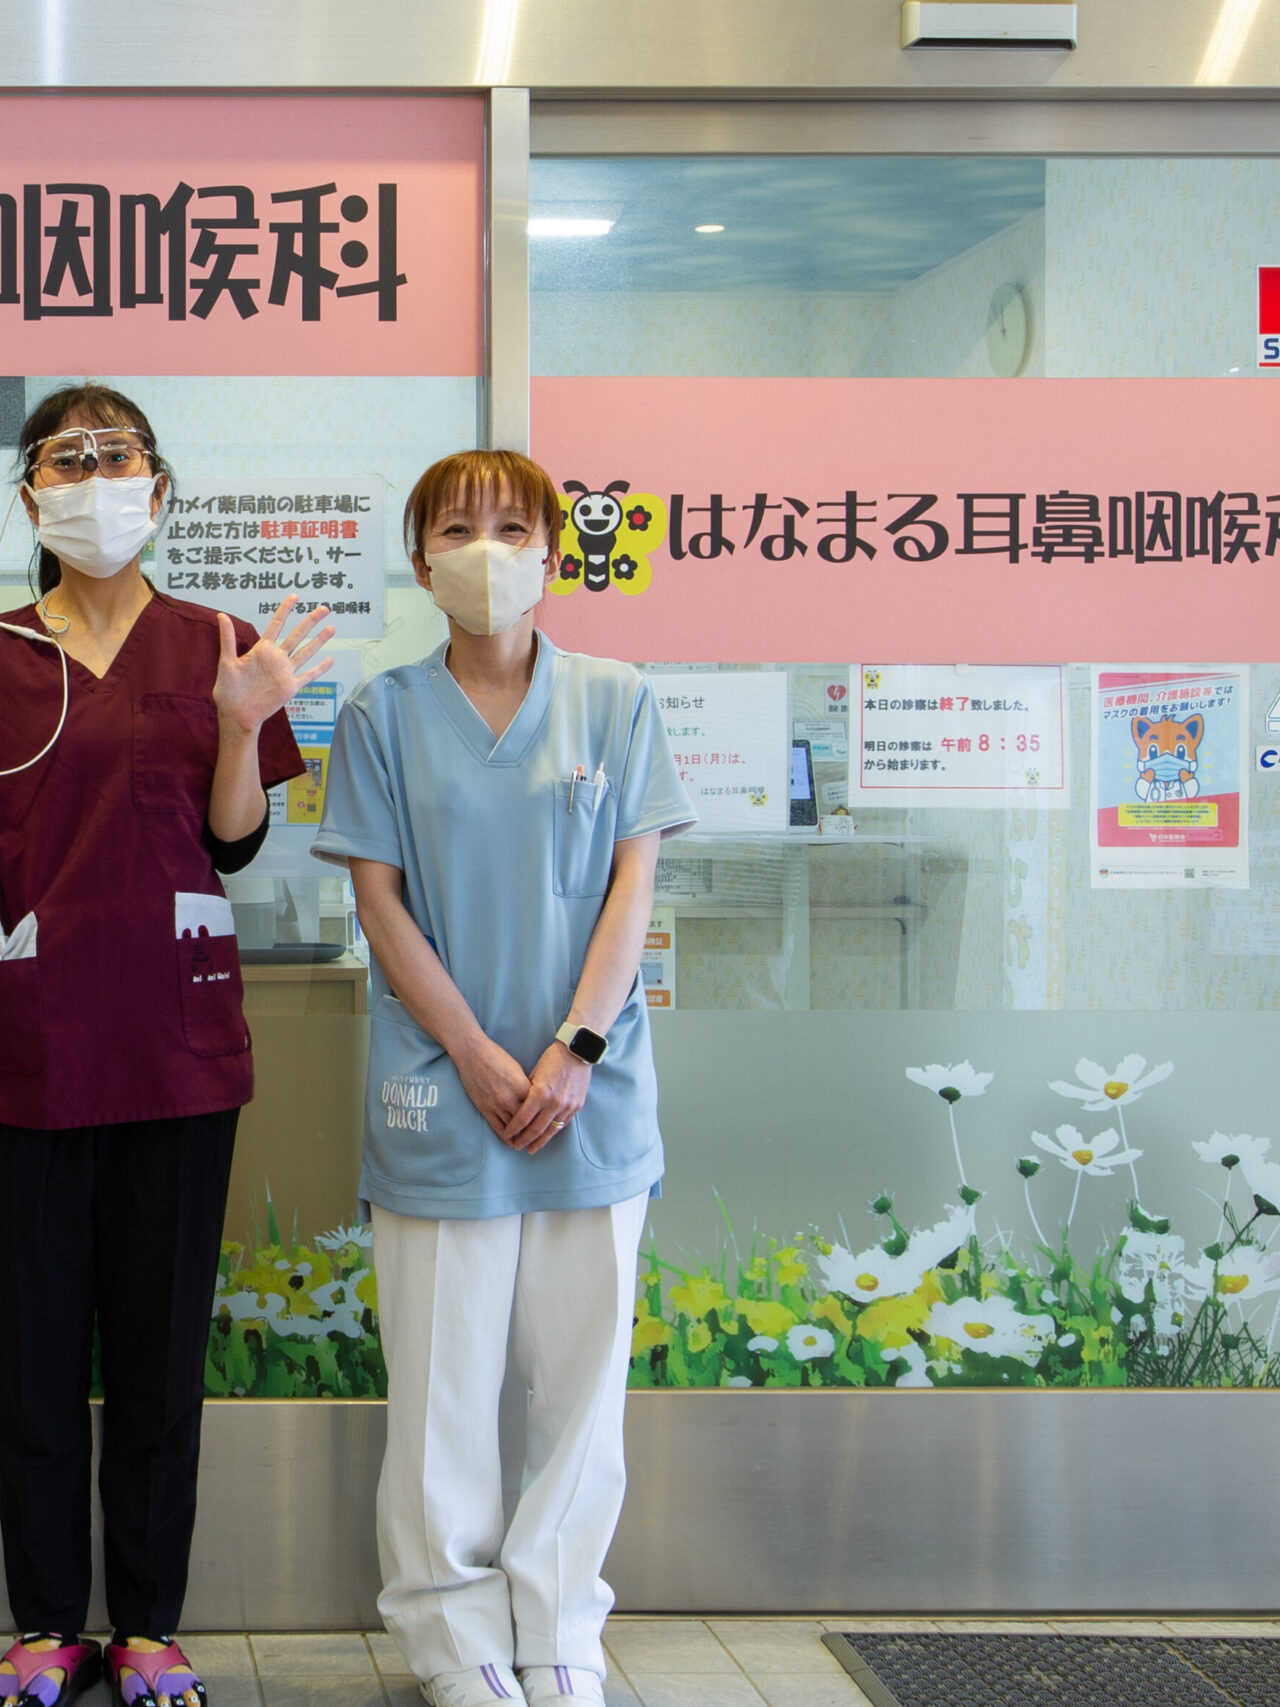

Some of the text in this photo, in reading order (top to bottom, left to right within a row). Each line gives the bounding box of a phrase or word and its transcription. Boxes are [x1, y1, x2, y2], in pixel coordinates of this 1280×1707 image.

[167, 495, 371, 514] カメイ薬局前の駐車場に
[167, 520, 359, 539] 止めた方は駐車証明書
[167, 572, 354, 590] ビス券をお出しします。
[1103, 685, 1234, 708] 医療機関、介護施設等では
[941, 738, 971, 752] 午前
[864, 759, 946, 771] から始まります。
[381, 1081, 438, 1107] DONALD
[387, 1106, 428, 1132] DUCK
